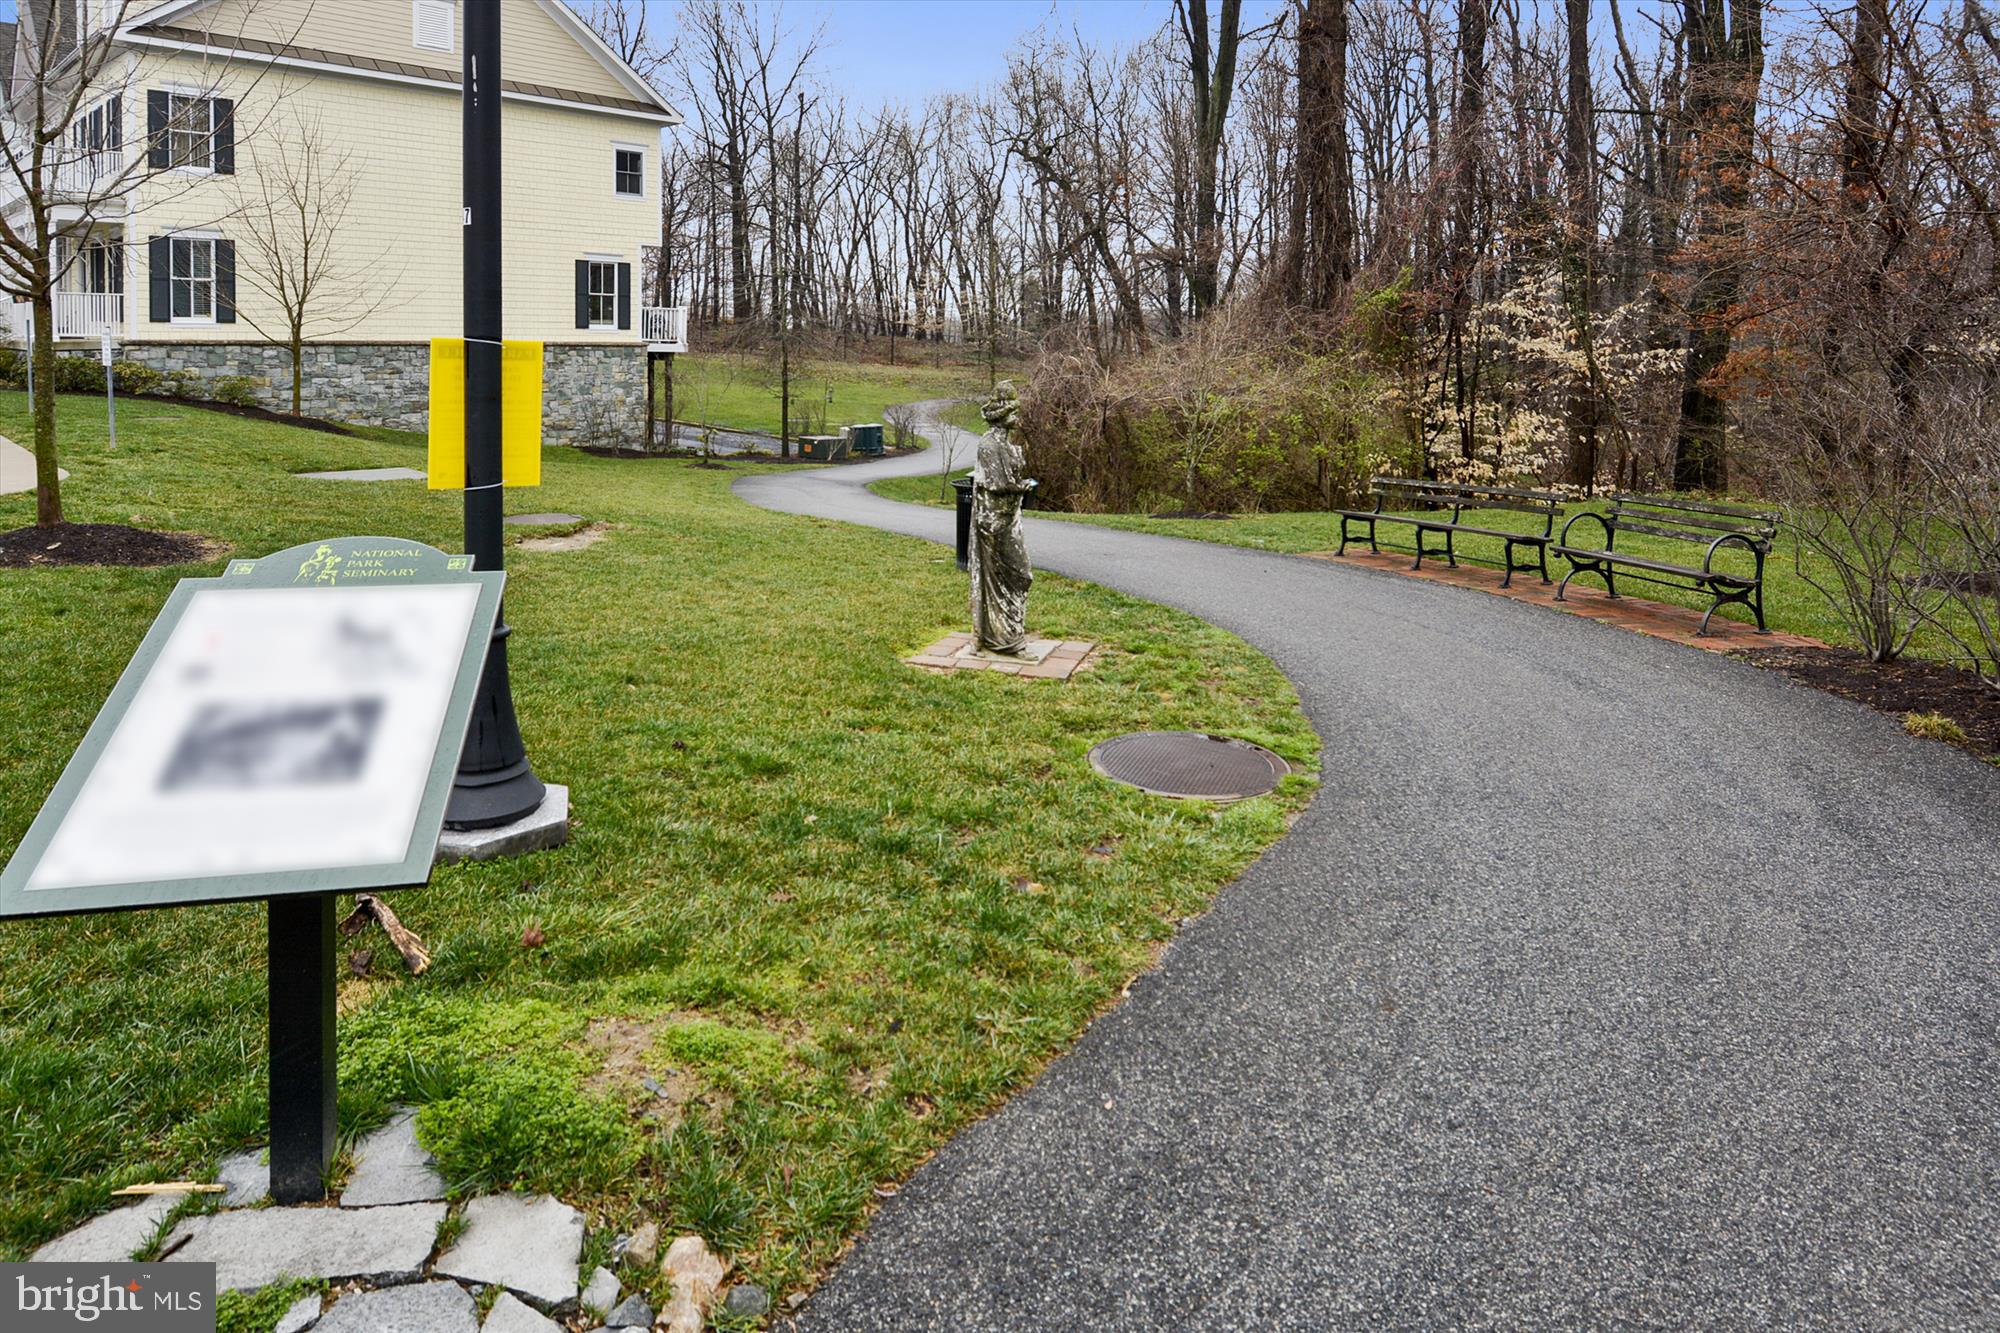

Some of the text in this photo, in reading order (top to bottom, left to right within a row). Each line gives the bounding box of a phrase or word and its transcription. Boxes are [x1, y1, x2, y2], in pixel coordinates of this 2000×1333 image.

[351, 549, 422, 558] NATIONAL
[347, 559, 384, 567] PARK
[342, 568, 418, 577] SEMINARY
